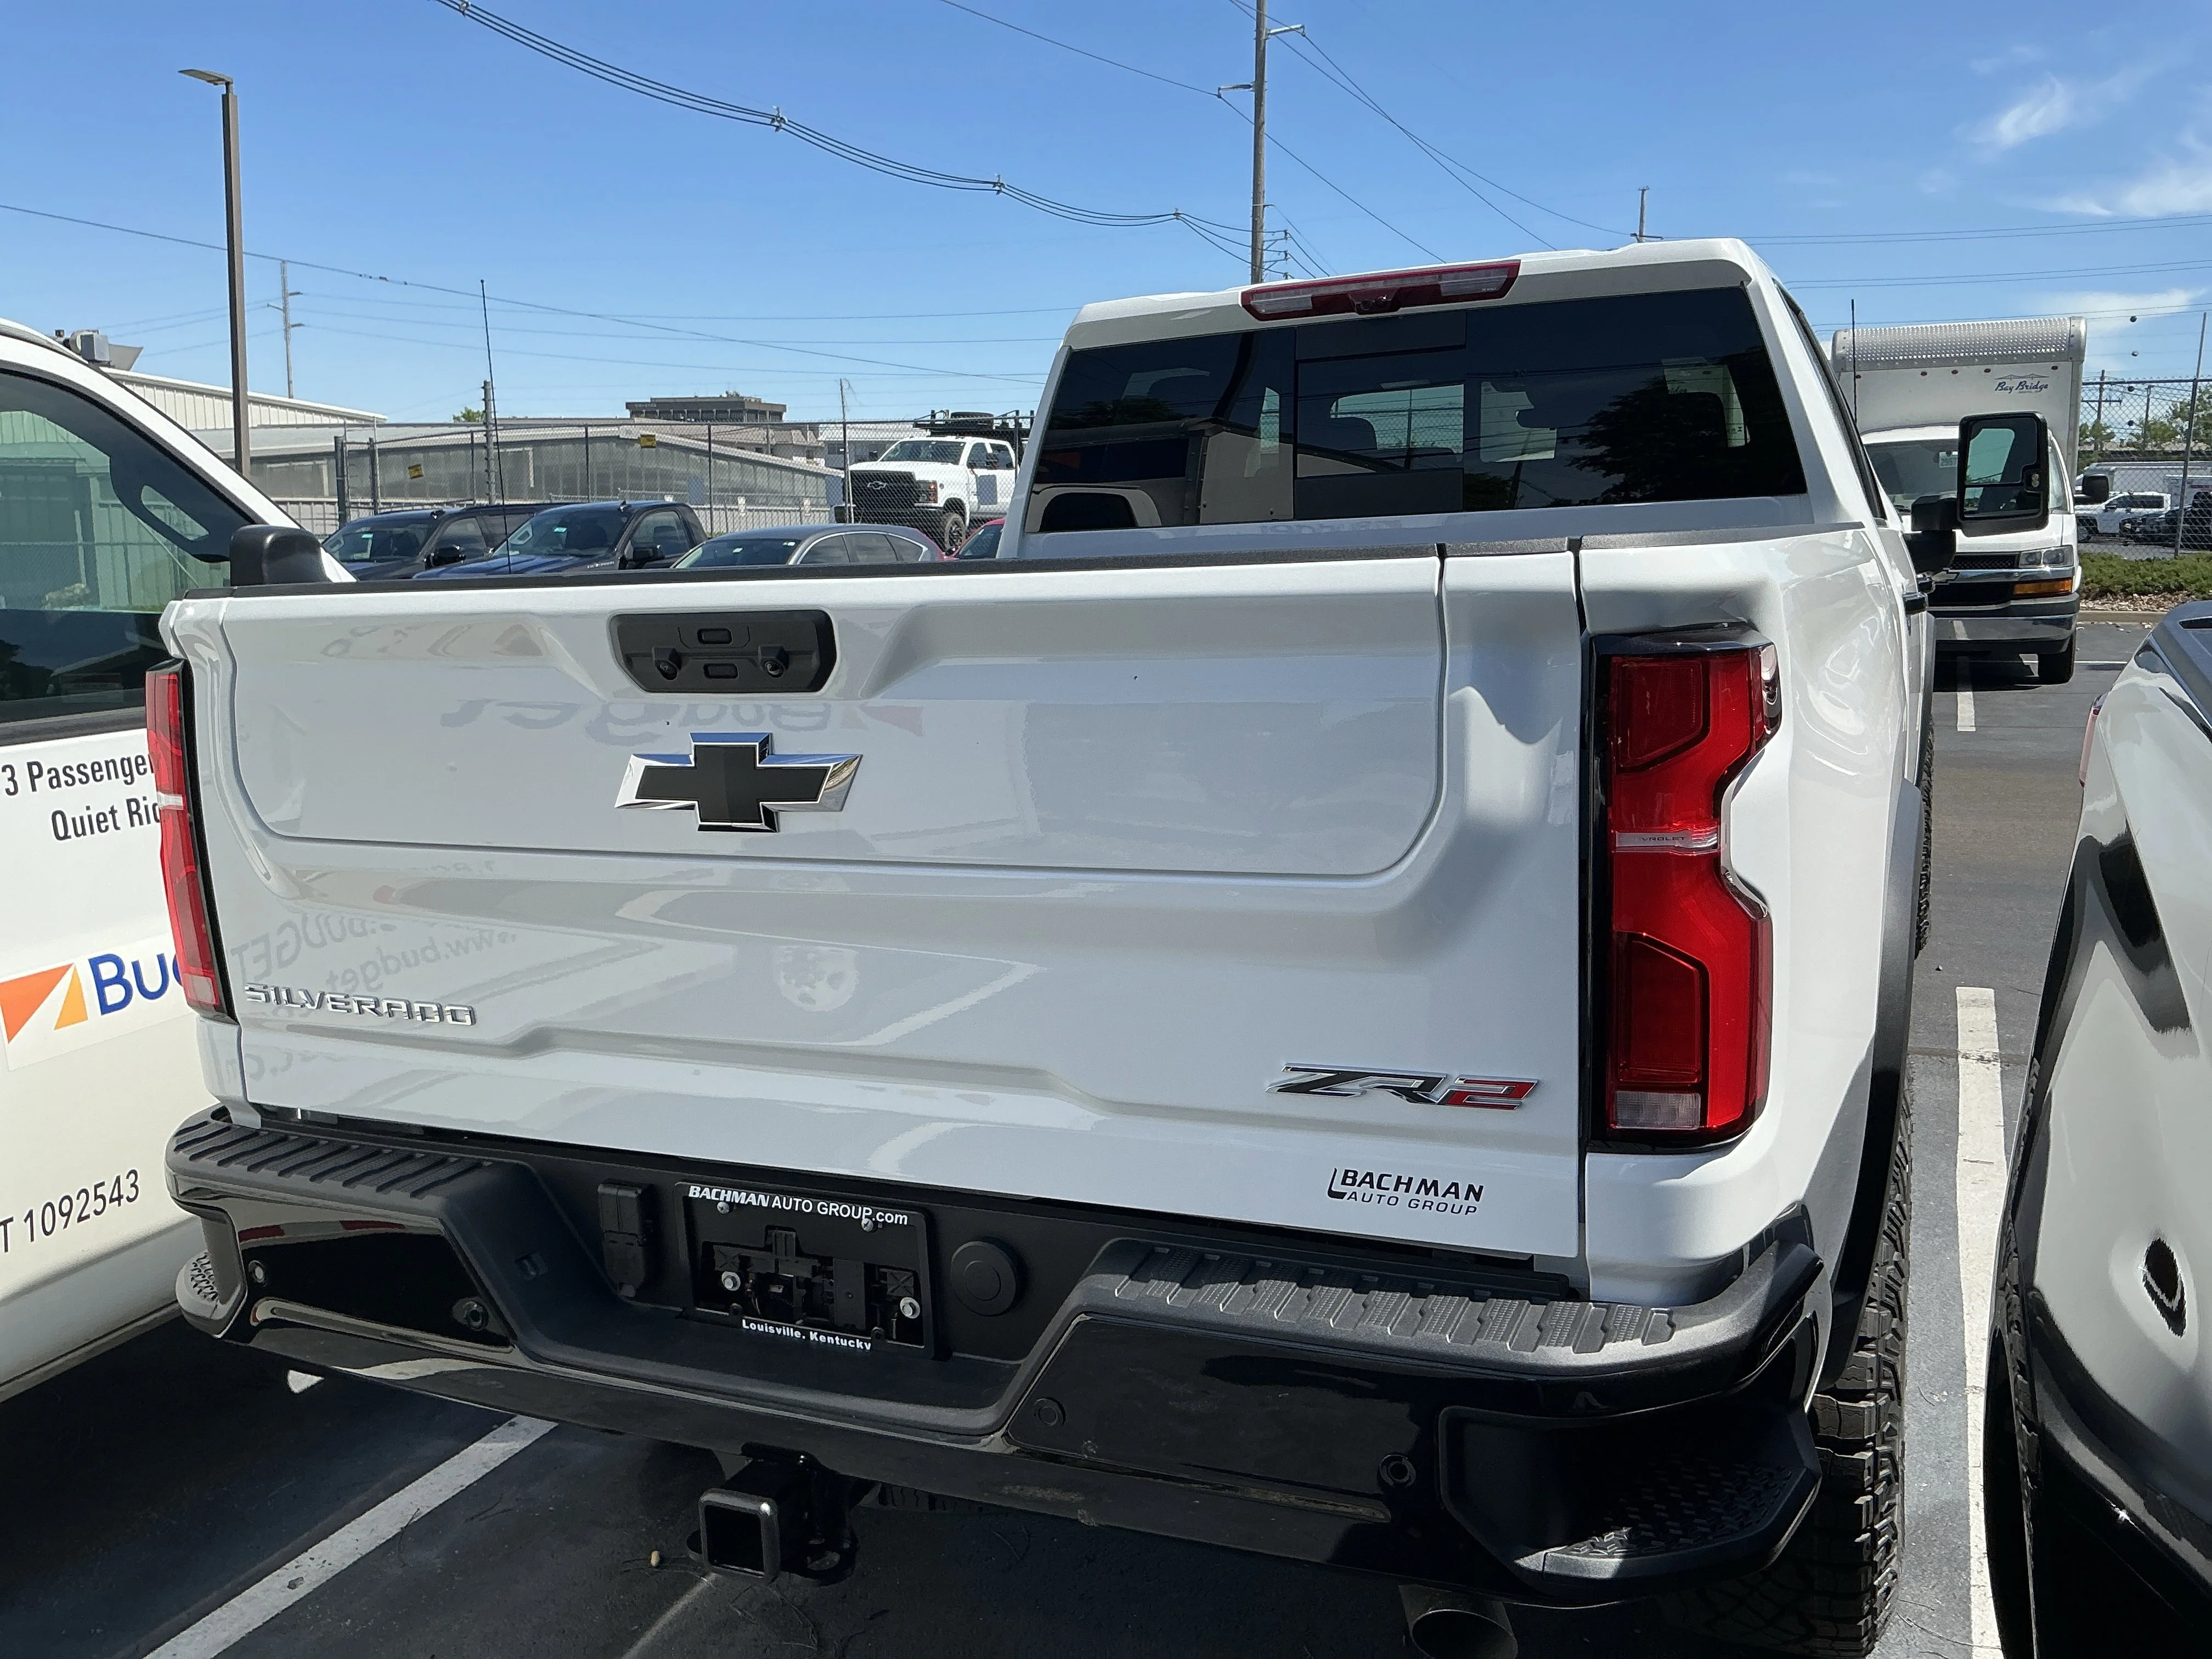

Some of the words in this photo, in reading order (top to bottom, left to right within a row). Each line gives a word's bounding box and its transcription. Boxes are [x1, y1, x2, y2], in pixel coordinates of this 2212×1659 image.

[1995, 381, 2014, 394] Bay
[2015, 380, 2049, 392] Bridge
[51, 805, 121, 840] Quiet
[245, 983, 477, 1026] SILVERADO
[1265, 1063, 1538, 1110] ZR2
[1340, 1169, 1485, 1203] BACHMAN
[23, 1169, 139, 1243] 1092543
[689, 1185, 769, 1207] BACHMAN
[771, 1195, 812, 1214] AUTO
[817, 1201, 909, 1226] GROUP.com
[1346, 1192, 1399, 1207] AUTO
[1408, 1199, 1477, 1216] GROUP
[809, 1331, 871, 1350] Kentucky
